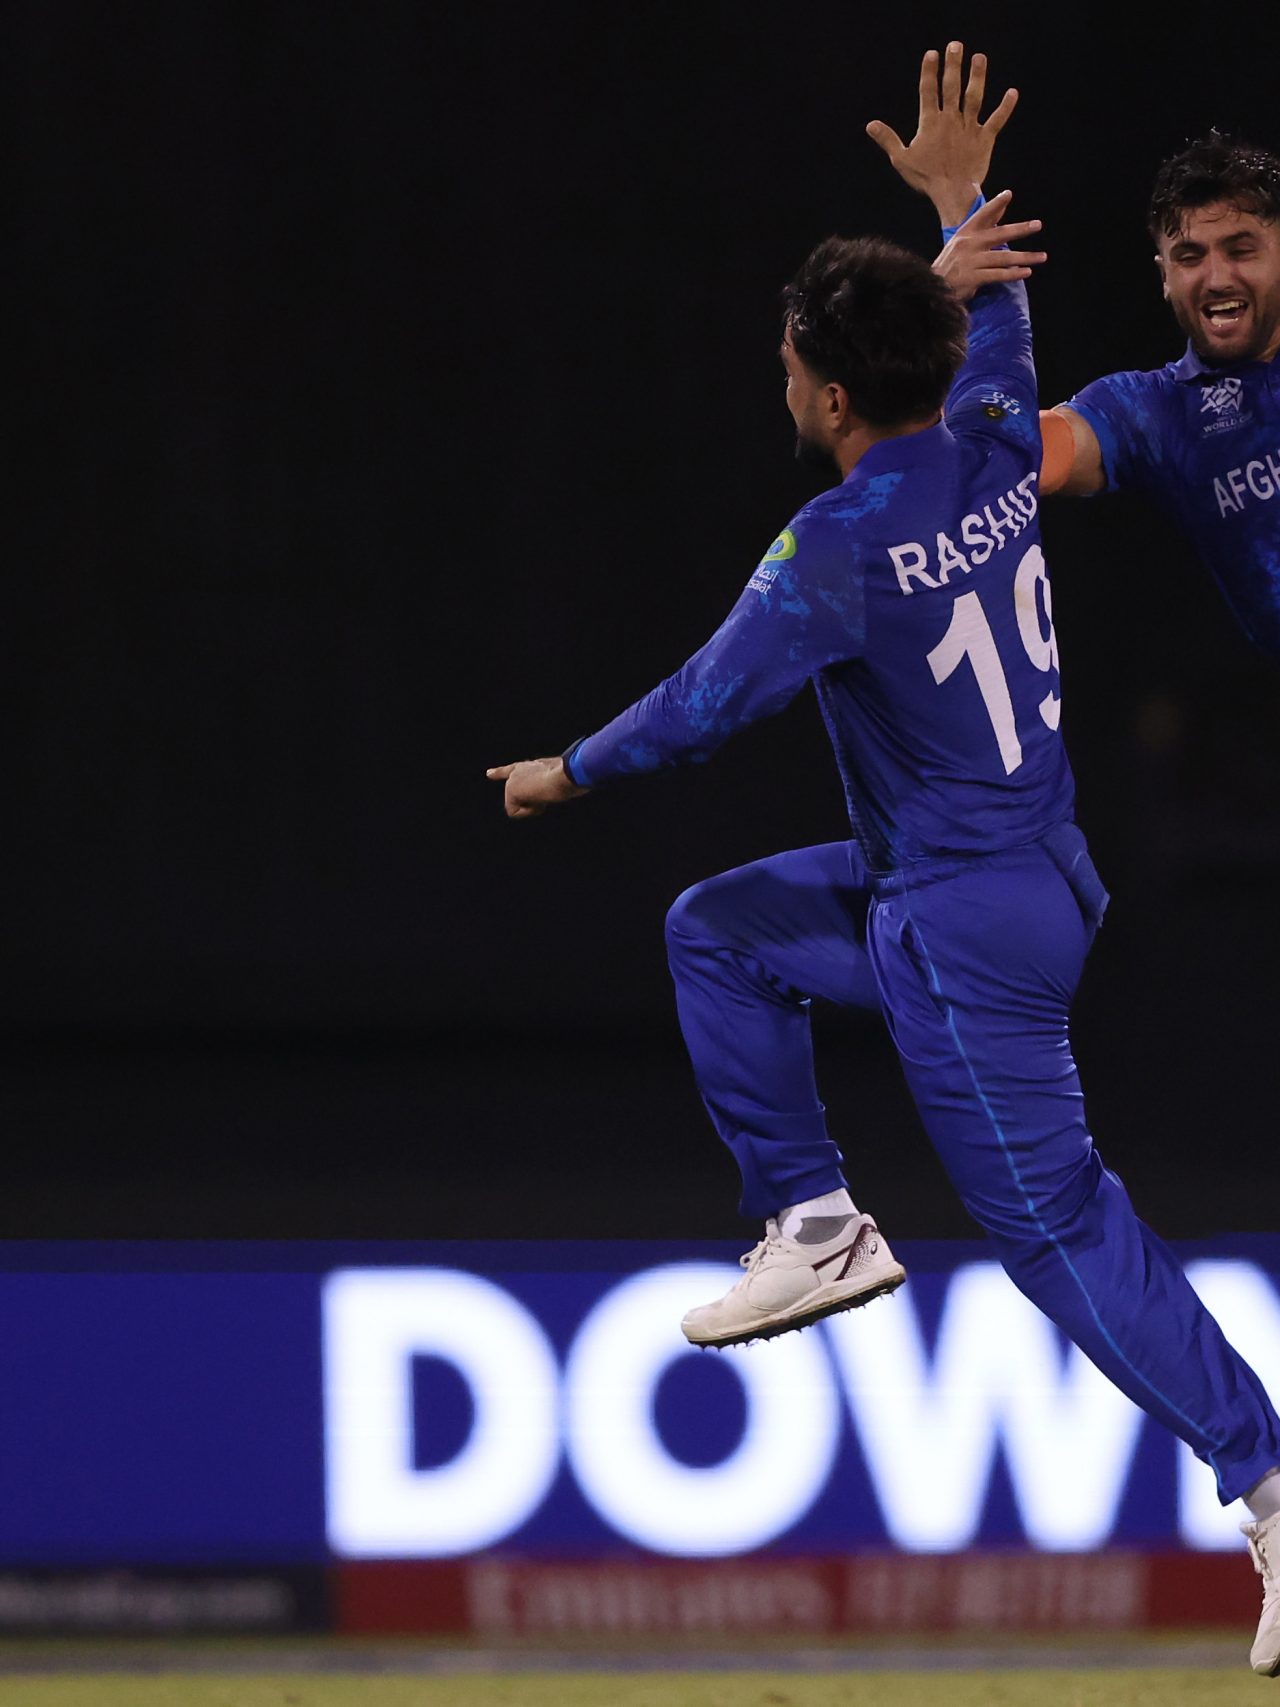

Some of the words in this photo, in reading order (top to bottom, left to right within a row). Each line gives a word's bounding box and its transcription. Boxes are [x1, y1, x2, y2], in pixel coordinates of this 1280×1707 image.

[1203, 418, 1238, 433] WORLD
[888, 471, 1038, 596] RASHID
[926, 543, 1061, 776] 19
